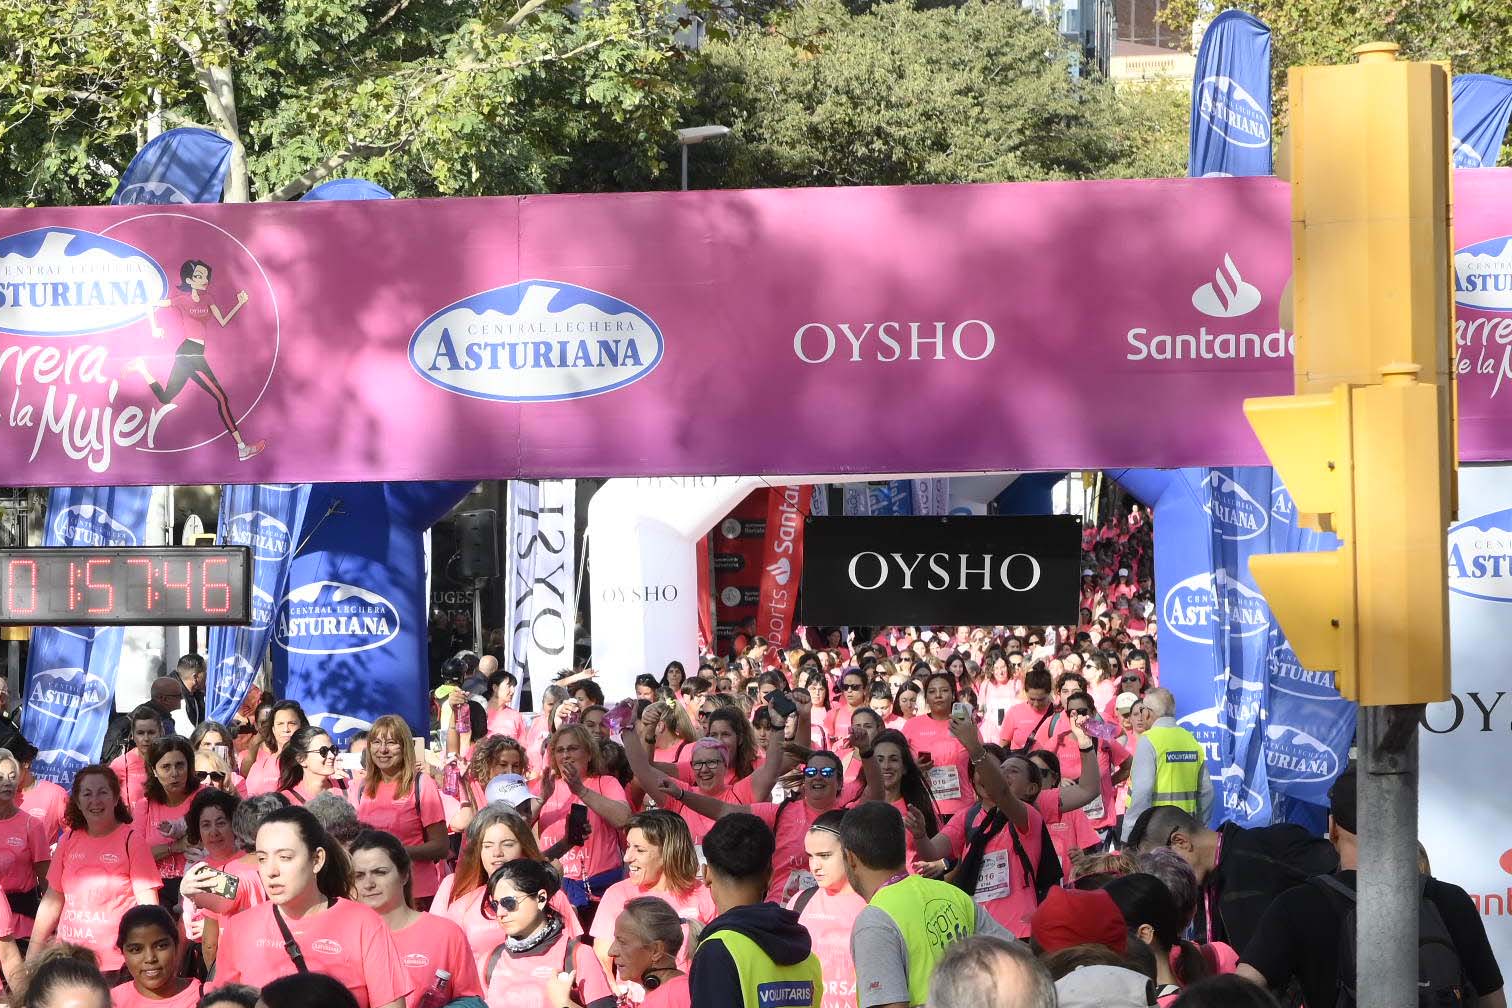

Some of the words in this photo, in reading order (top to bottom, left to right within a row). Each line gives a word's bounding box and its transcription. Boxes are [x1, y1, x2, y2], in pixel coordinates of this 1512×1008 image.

[466, 321, 545, 335] CENTRAL
[548, 321, 636, 333] LECHERA
[794, 320, 996, 364] OYSHO
[1127, 327, 1294, 362] Santand
[428, 328, 643, 372] ASTURIANA
[8, 387, 35, 429] la
[28, 380, 179, 473] Mujer
[8, 559, 230, 613] 01:57:46
[848, 551, 1041, 591] OYSHO
[290, 605, 333, 615] CENTRAL
[337, 604, 386, 614] LECHERA
[602, 584, 678, 602] OYSHO
[278, 612, 391, 638] ASTURIANA
[566, 847, 590, 860] SAL
